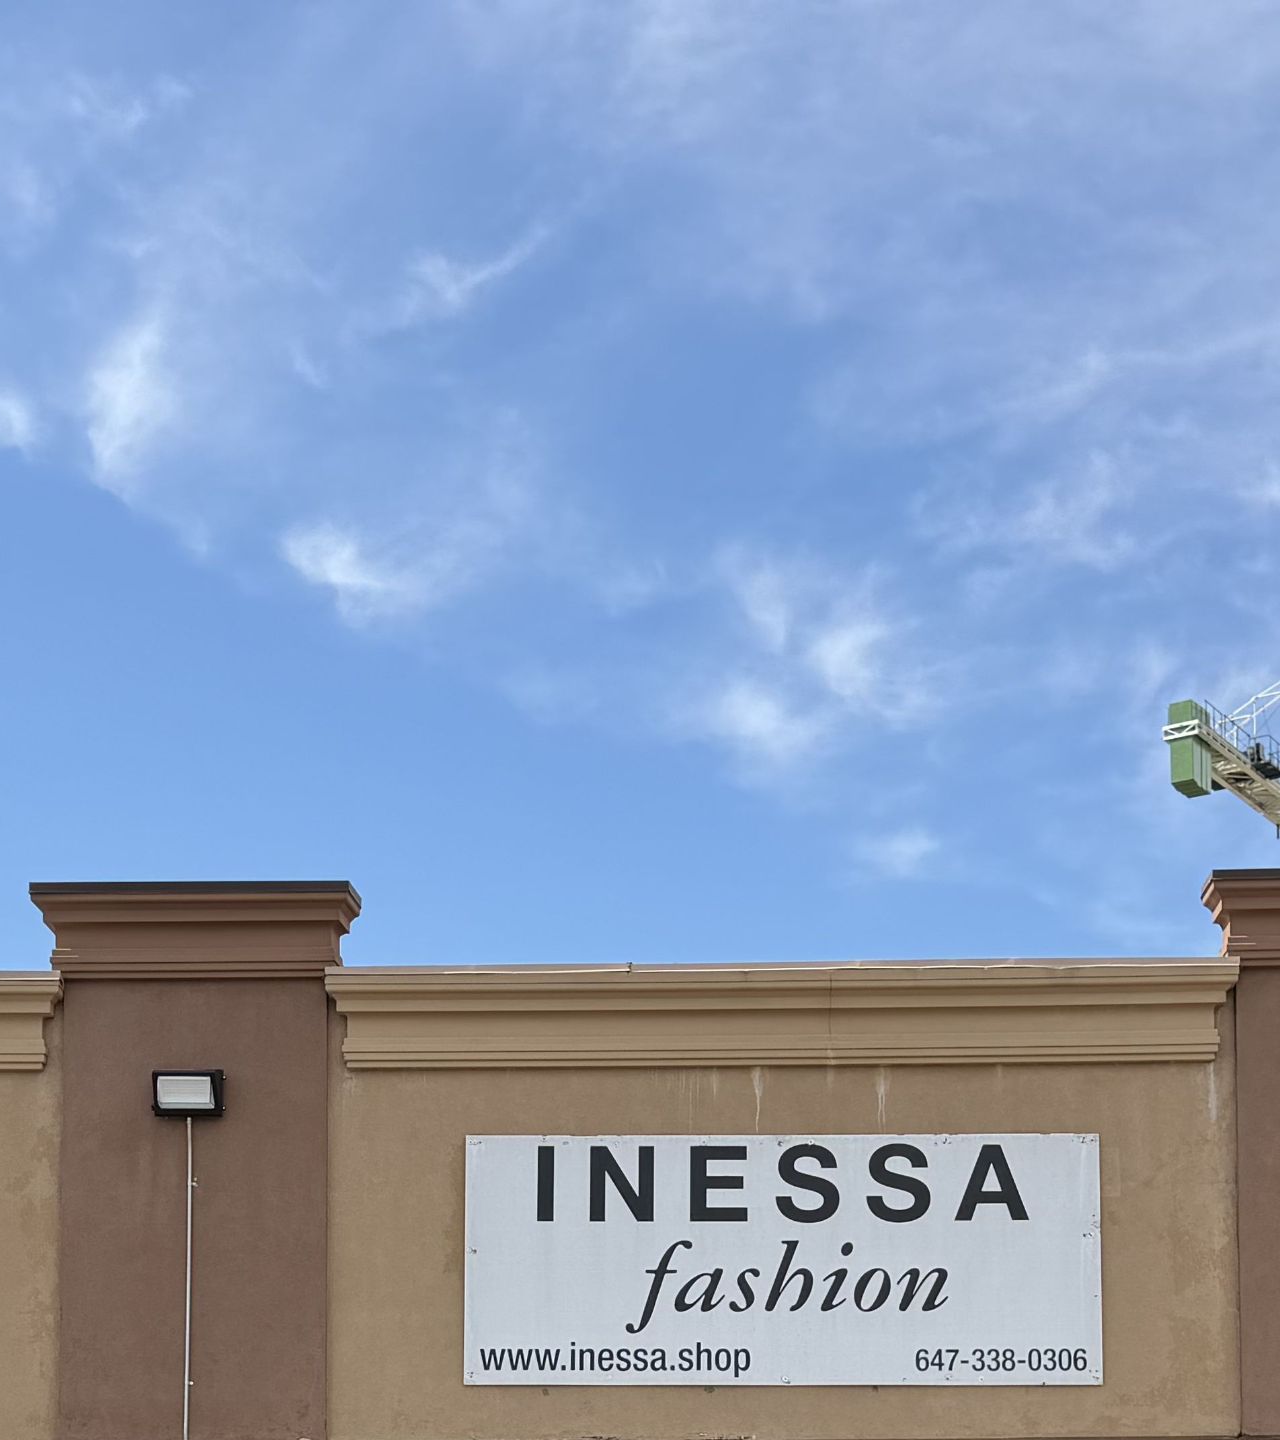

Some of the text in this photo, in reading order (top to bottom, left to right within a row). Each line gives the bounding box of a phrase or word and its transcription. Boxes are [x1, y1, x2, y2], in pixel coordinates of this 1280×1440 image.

[536, 1142, 1030, 1223] INESSA
[625, 1240, 949, 1334] fashion
[479, 1341, 752, 1378] www.inessa.shop
[913, 1347, 1088, 1373] 647-338-0306
